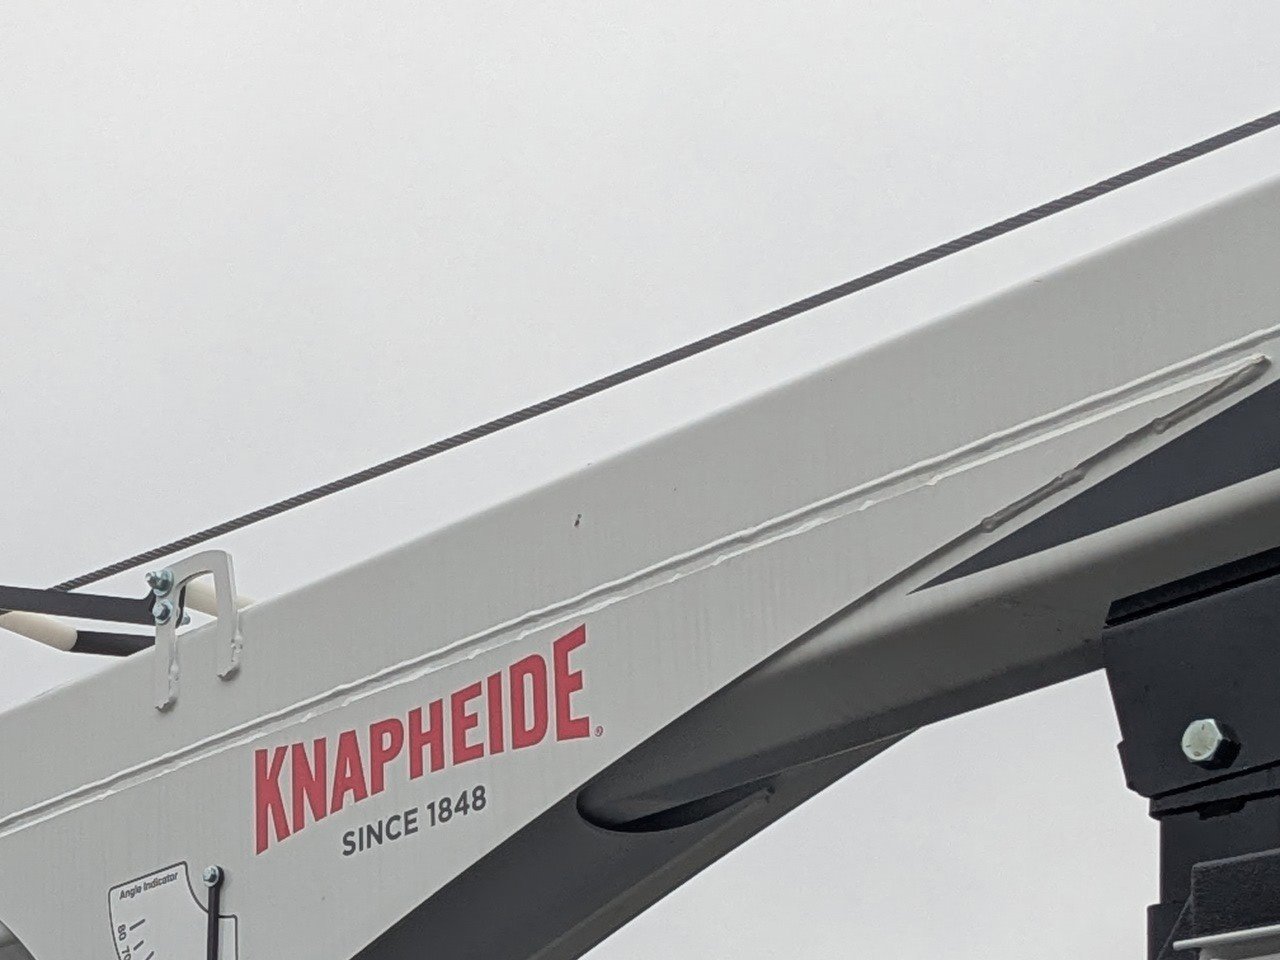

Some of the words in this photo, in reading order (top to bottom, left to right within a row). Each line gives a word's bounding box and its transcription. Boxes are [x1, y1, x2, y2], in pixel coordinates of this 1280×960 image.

[255, 623, 590, 855] KNAPHEIDE
[342, 807, 419, 856] SINCE
[426, 784, 487, 827] 1848
[119, 885, 142, 900] Angle
[143, 872, 178, 890] Indicator
[117, 924, 127, 941] 80
